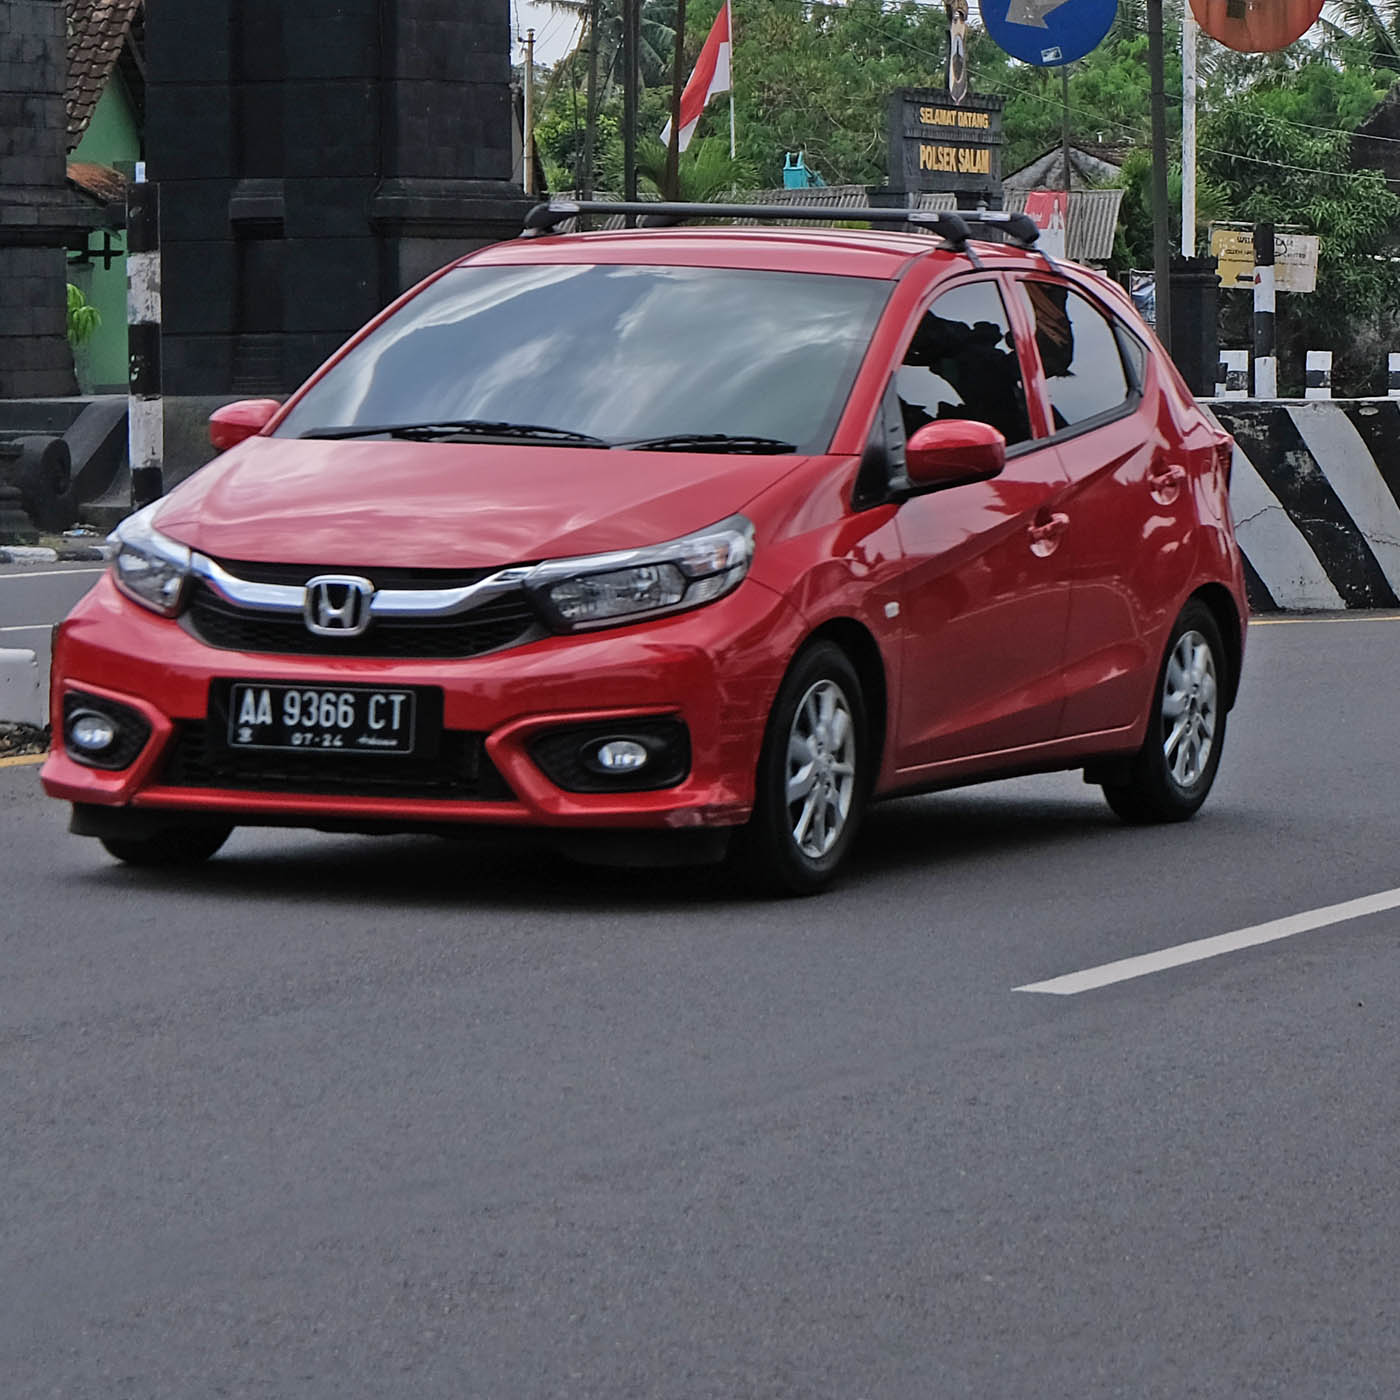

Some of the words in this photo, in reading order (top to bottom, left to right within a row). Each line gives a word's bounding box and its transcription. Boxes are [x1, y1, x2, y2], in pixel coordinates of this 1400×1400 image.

[920, 107, 957, 126] SELAMAT
[958, 111, 989, 128] DATANG
[920, 145, 957, 172] POLSEK
[958, 148, 989, 174] SALAM
[239, 689, 272, 725] AA
[282, 690, 355, 728] 9366
[368, 694, 407, 730] CT
